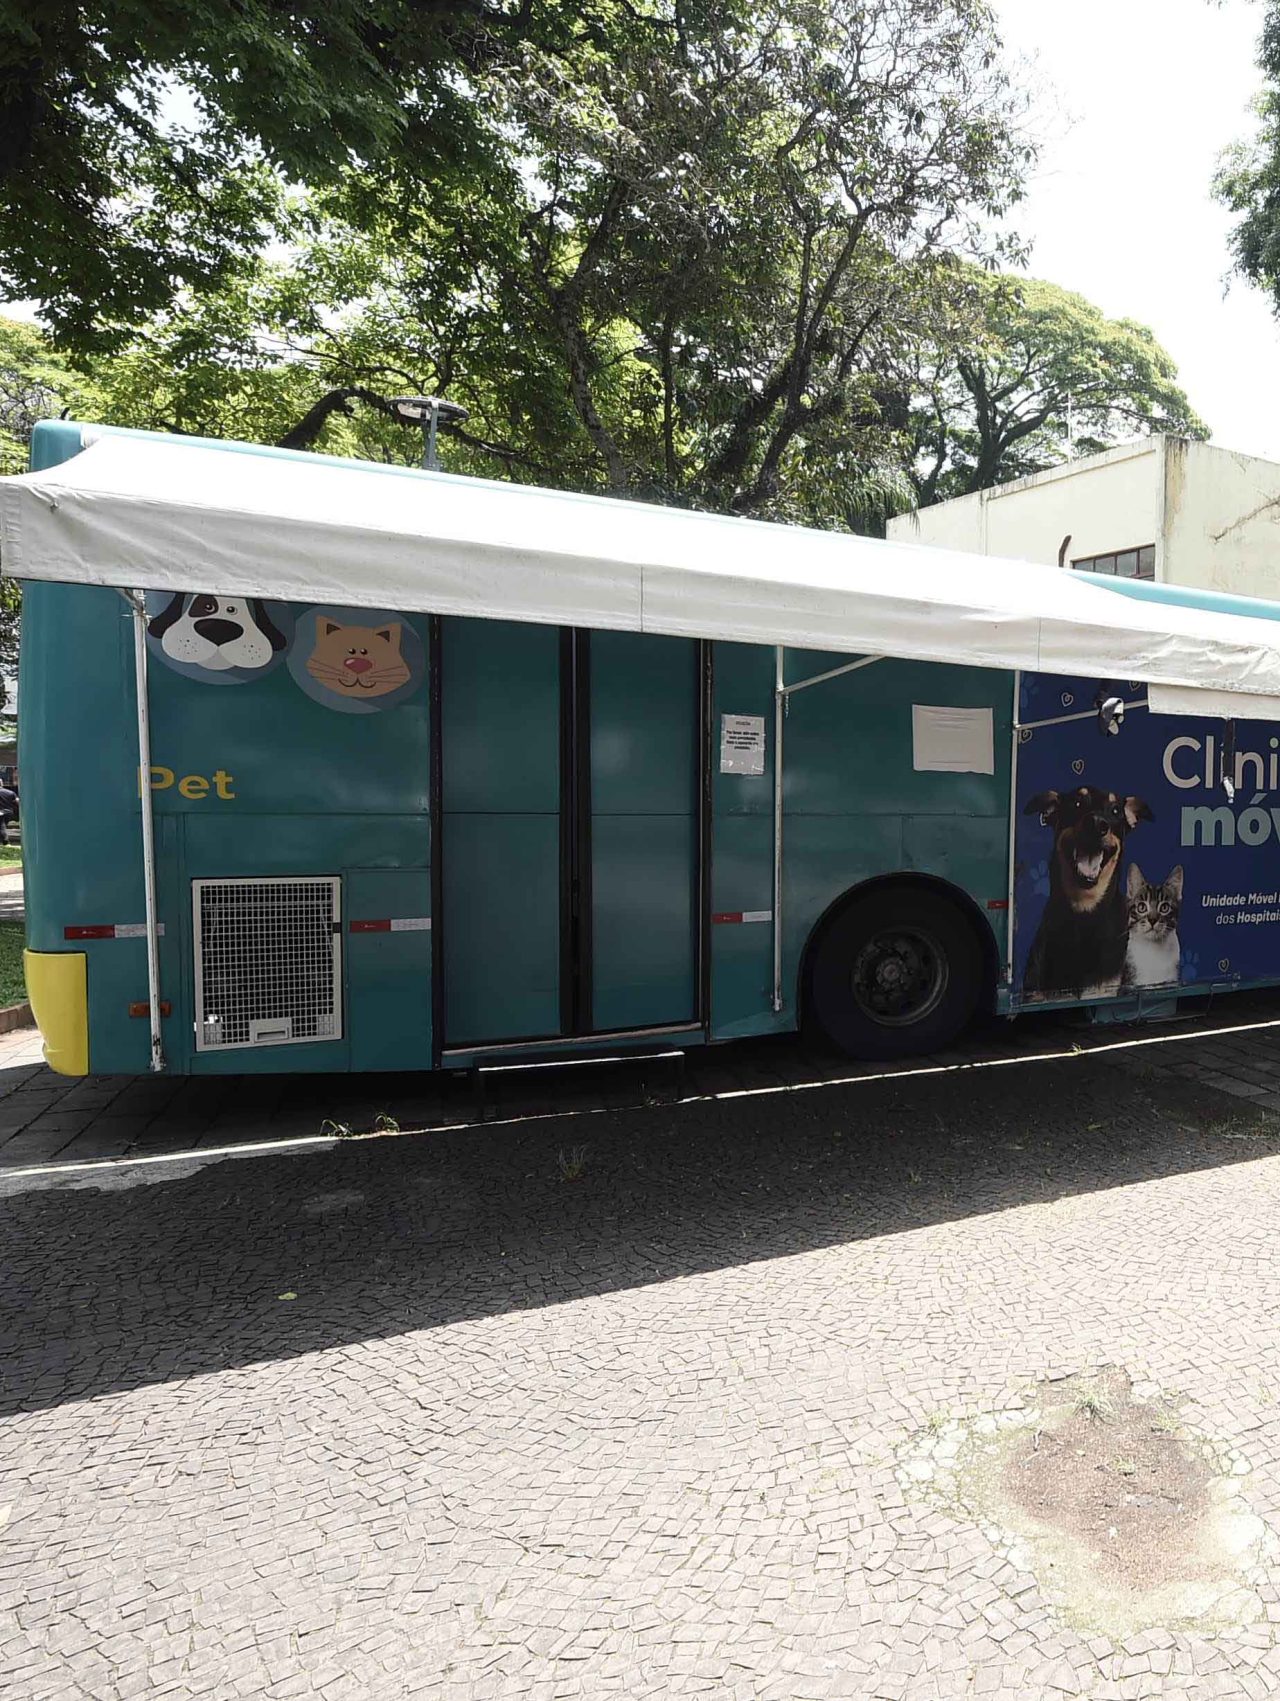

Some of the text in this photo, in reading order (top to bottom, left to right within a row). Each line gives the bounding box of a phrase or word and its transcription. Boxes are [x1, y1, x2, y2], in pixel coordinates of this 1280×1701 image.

[137, 766, 236, 800] Pet
[1201, 894, 1247, 907] Unidade
[1247, 892, 1277, 905] Móvel
[1215, 912, 1235, 925] dos
